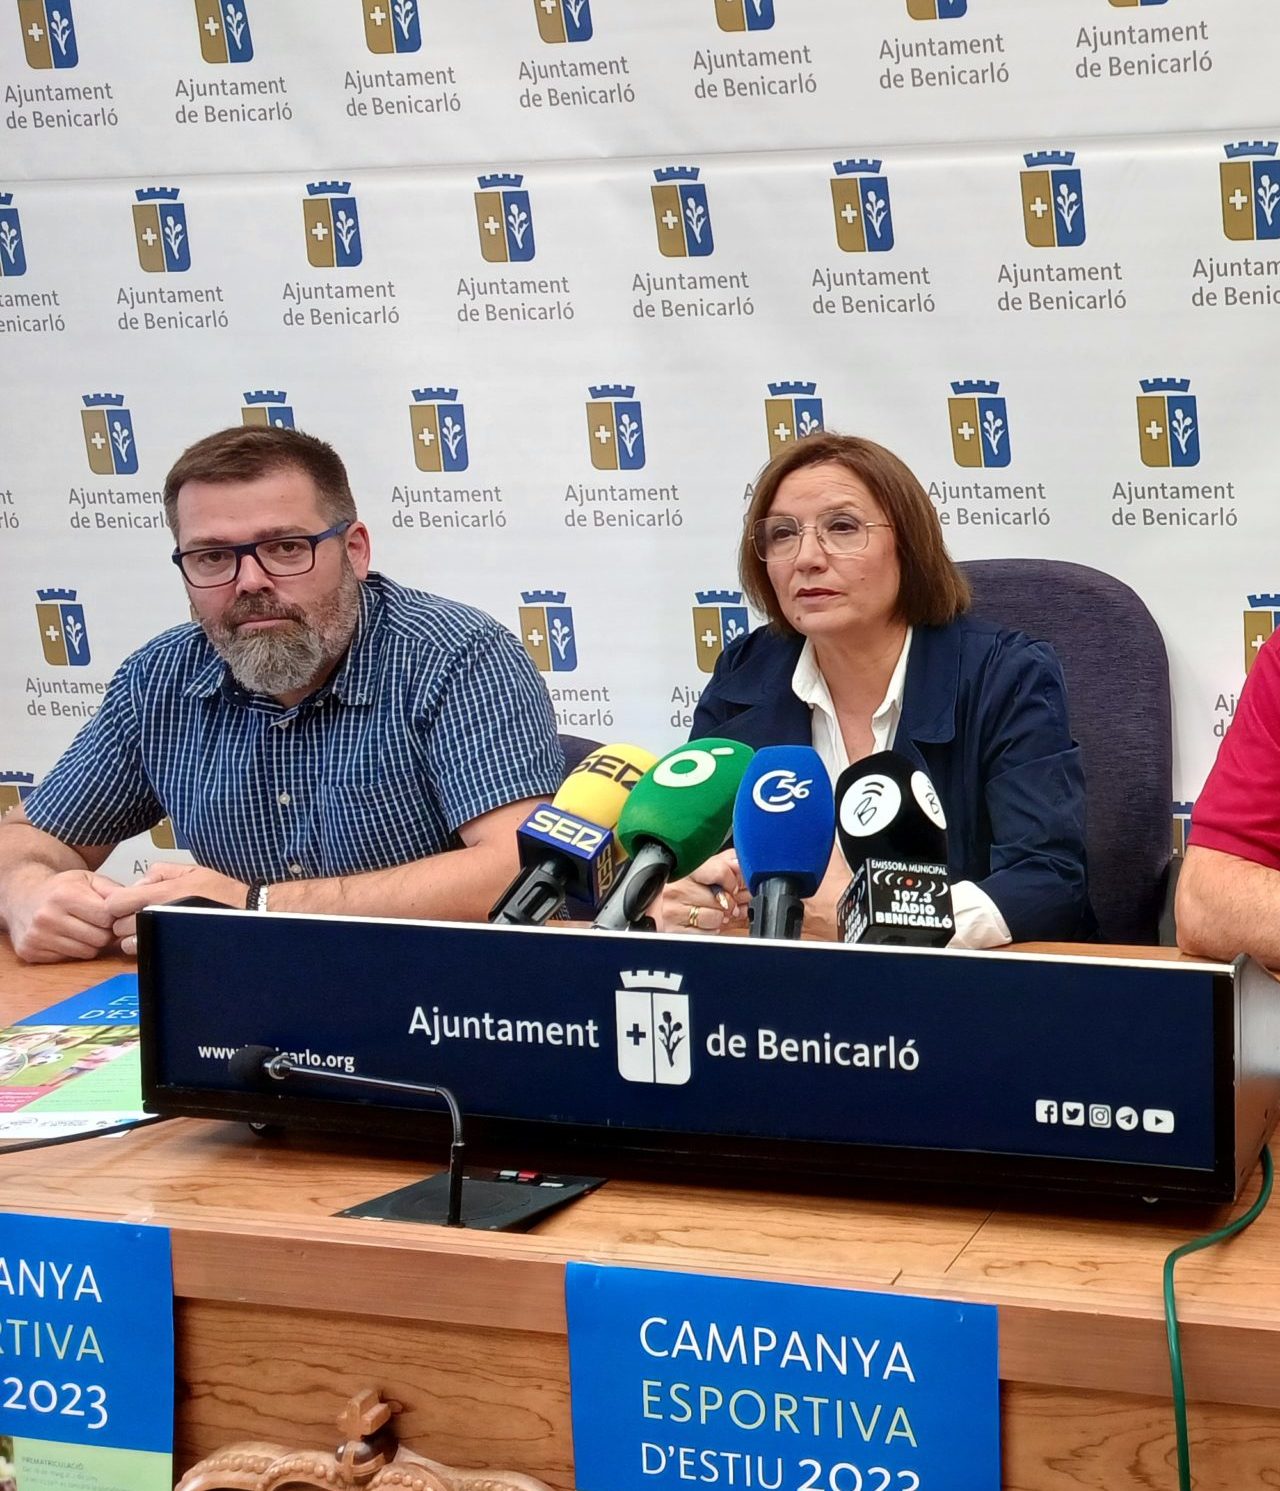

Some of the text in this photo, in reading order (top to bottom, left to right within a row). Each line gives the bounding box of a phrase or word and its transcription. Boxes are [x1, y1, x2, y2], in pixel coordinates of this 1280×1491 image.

[879, 33, 1005, 65] Ajuntament
[1075, 20, 1209, 54] Ajuntament
[518, 55, 630, 86] Ajuntament
[693, 44, 813, 76] Ajuntament
[1075, 49, 1213, 79] de Benicarló
[344, 66, 457, 95] Ajuntament
[694, 72, 817, 99] de Benicarló
[879, 61, 1010, 90] de Benicarló
[4, 82, 114, 109] Ajuntament
[175, 76, 288, 103] Ajuntament
[519, 82, 636, 109] de Benicarló
[175, 101, 293, 124] de Benicarló
[346, 91, 462, 117] de Benicarló
[5, 106, 119, 130] de Benicarló
[631, 271, 750, 297] Ajuntament
[811, 266, 931, 293] Ajuntament
[997, 261, 1123, 289] Ajuntament
[116, 285, 224, 310] Ajuntament
[282, 280, 396, 306] Ajuntament
[456, 276, 571, 302] Ajuntament
[997, 288, 1127, 312] de Benicarló
[1191, 285, 1218, 307] de
[457, 300, 575, 323] de Benicarló
[632, 295, 755, 319] de Benicarló
[812, 292, 936, 315] de Benicarló
[0, 313, 66, 333] enicarló
[117, 309, 229, 331] de Benicarló
[282, 305, 400, 327] de Benicarló
[68, 487, 163, 510] Ajuntamen
[391, 485, 503, 509] Ajuntament
[564, 483, 680, 507] Ajuntament
[929, 481, 1047, 505] Ajuntament
[1111, 481, 1236, 506] Ajuntament
[70, 511, 91, 529] de
[391, 509, 507, 528] de Benicarló
[564, 507, 683, 528] de Benicarló
[957, 506, 1051, 526] Benicarló
[1111, 506, 1238, 527] de Benicarló
[25, 677, 107, 699] Ajuntame
[551, 686, 611, 702] ament
[26, 699, 101, 717] de Benic
[555, 708, 614, 727] nicarló
[670, 710, 693, 728] de
[1213, 718, 1226, 738] d
[526, 810, 603, 853] SER
[871, 859, 948, 876] EMISSORA MUNICIPAL
[893, 889, 933, 904] 107.3
[875, 911, 953, 929] BENICARLÓ
[78, 1009, 139, 1020] D'ES
[408, 1004, 920, 1072] Ajuntament de Benicarló
[0, 1258, 103, 1303] ANYA
[639, 1315, 916, 1384] CAMPANYA
[3, 1377, 109, 1429] 2023
[641, 1379, 919, 1448] ESPORTIVA
[640, 1442, 784, 1491] D'ESTIU
